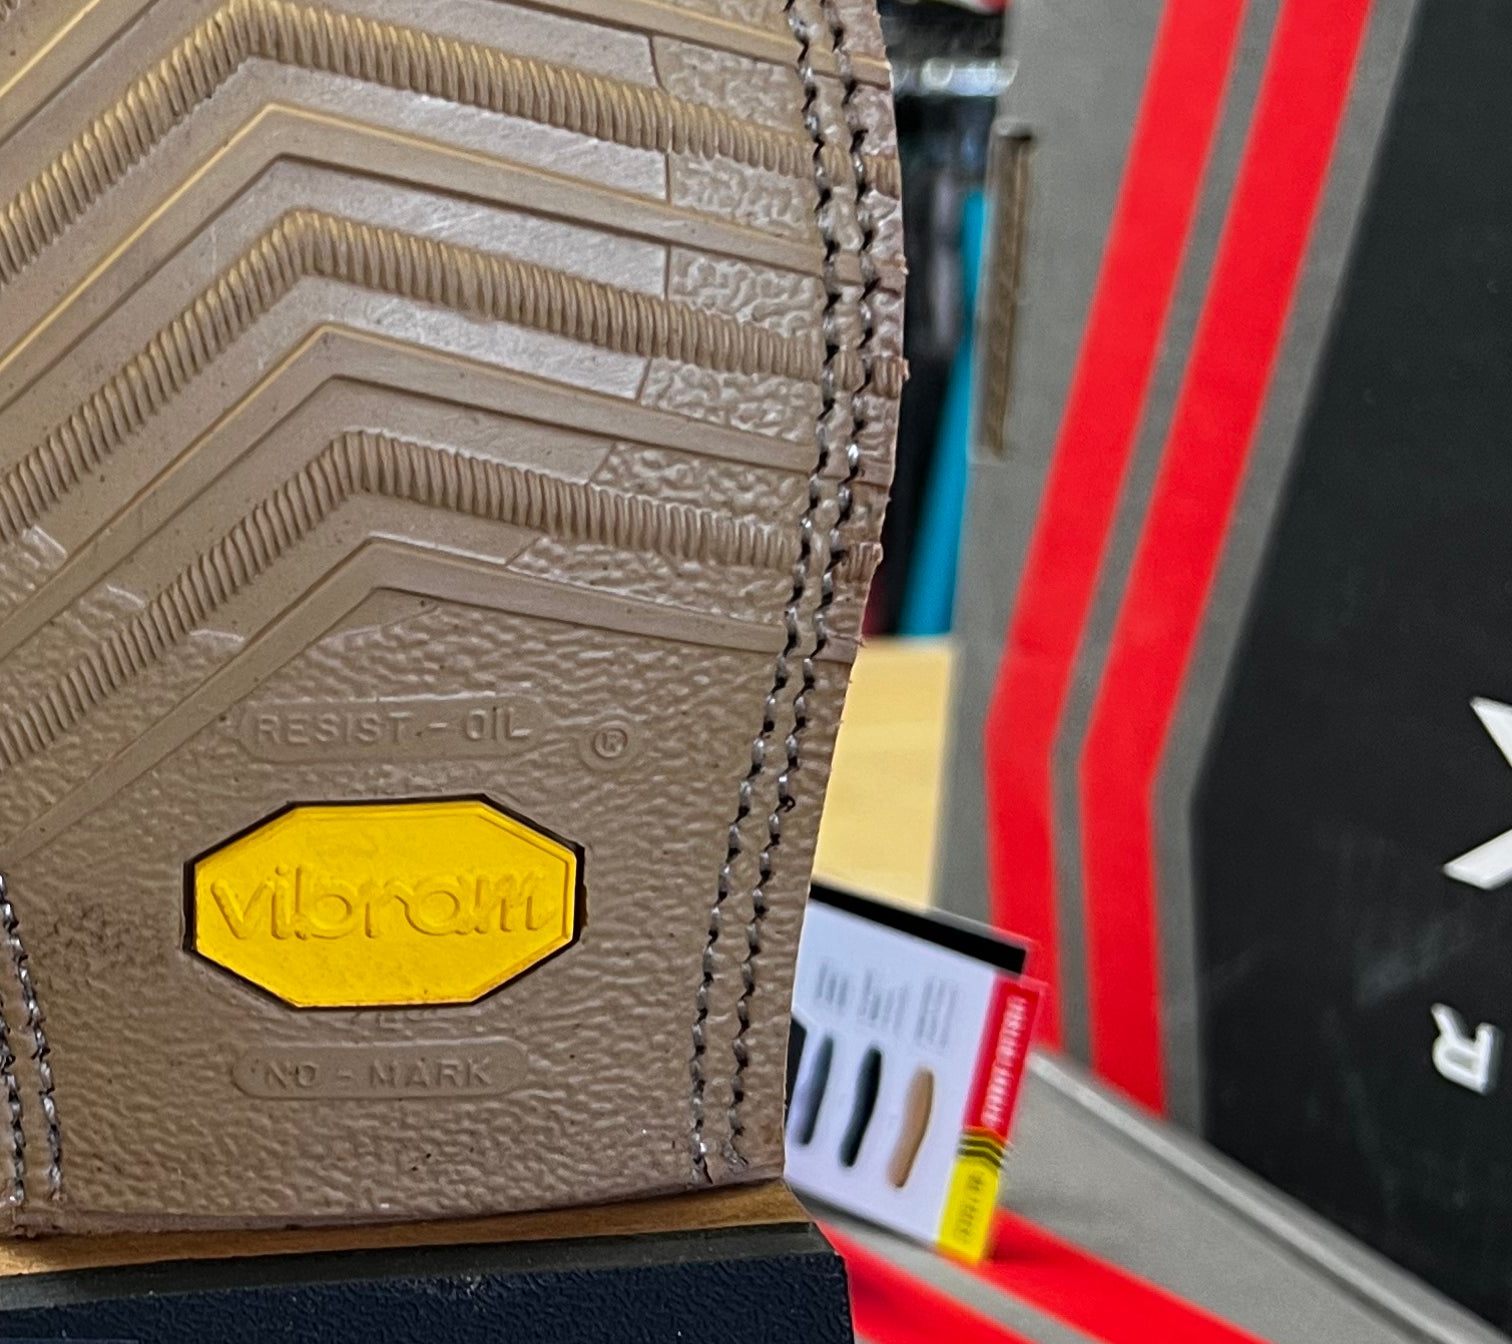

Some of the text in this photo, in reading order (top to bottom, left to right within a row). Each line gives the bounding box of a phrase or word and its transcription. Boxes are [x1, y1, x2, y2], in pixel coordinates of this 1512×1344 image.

[256, 710, 414, 746] RESIST
[463, 707, 534, 742] OIL
[209, 863, 552, 941] vibram
[264, 1061, 319, 1088] NO
[369, 1058, 492, 1088] MARK
